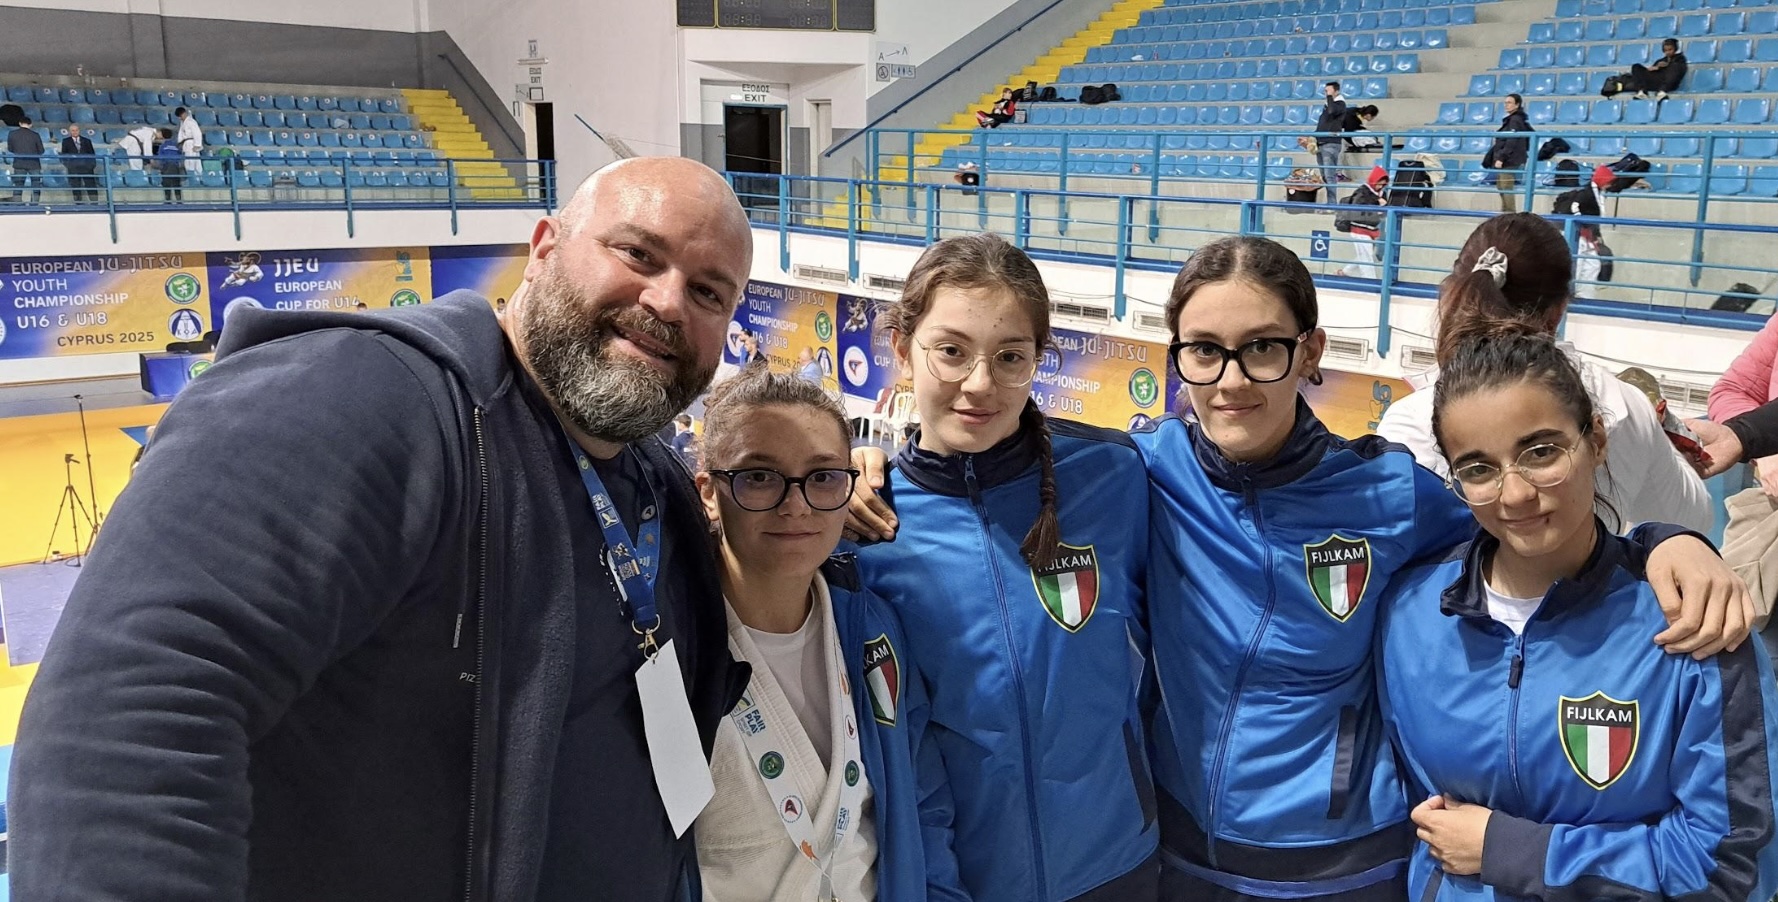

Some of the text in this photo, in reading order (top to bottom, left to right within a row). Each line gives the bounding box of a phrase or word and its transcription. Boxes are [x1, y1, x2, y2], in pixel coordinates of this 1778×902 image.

[744, 94, 767, 102] EXIT
[11, 256, 183, 275] EUROPEAN JU-JITSU
[12, 278, 68, 292] YOUTH
[275, 280, 342, 294] EUROPEAN
[14, 293, 129, 308] CHAMPIONSHIP
[276, 296, 360, 310] CUP FOR U14
[748, 284, 825, 306] EUROPEAN JU-JITSU
[748, 298, 772, 313] YOUTH
[17, 312, 108, 329] U16 & U18
[748, 313, 798, 332] CHAMPIONSHIP
[57, 332, 155, 347] CYPRUS 2025
[766, 334, 771, 344] &
[774, 336, 788, 349] U18
[1052, 336, 1147, 363] PEAN JU-JITSU
[1033, 371, 1100, 394] AMPIONSHIP
[1031, 390, 1082, 414] 16 & U18
[1038, 554, 1092, 572] JLKAM
[1311, 547, 1365, 564] FIJLKAM
[1567, 706, 1632, 722] FIJLKAM
